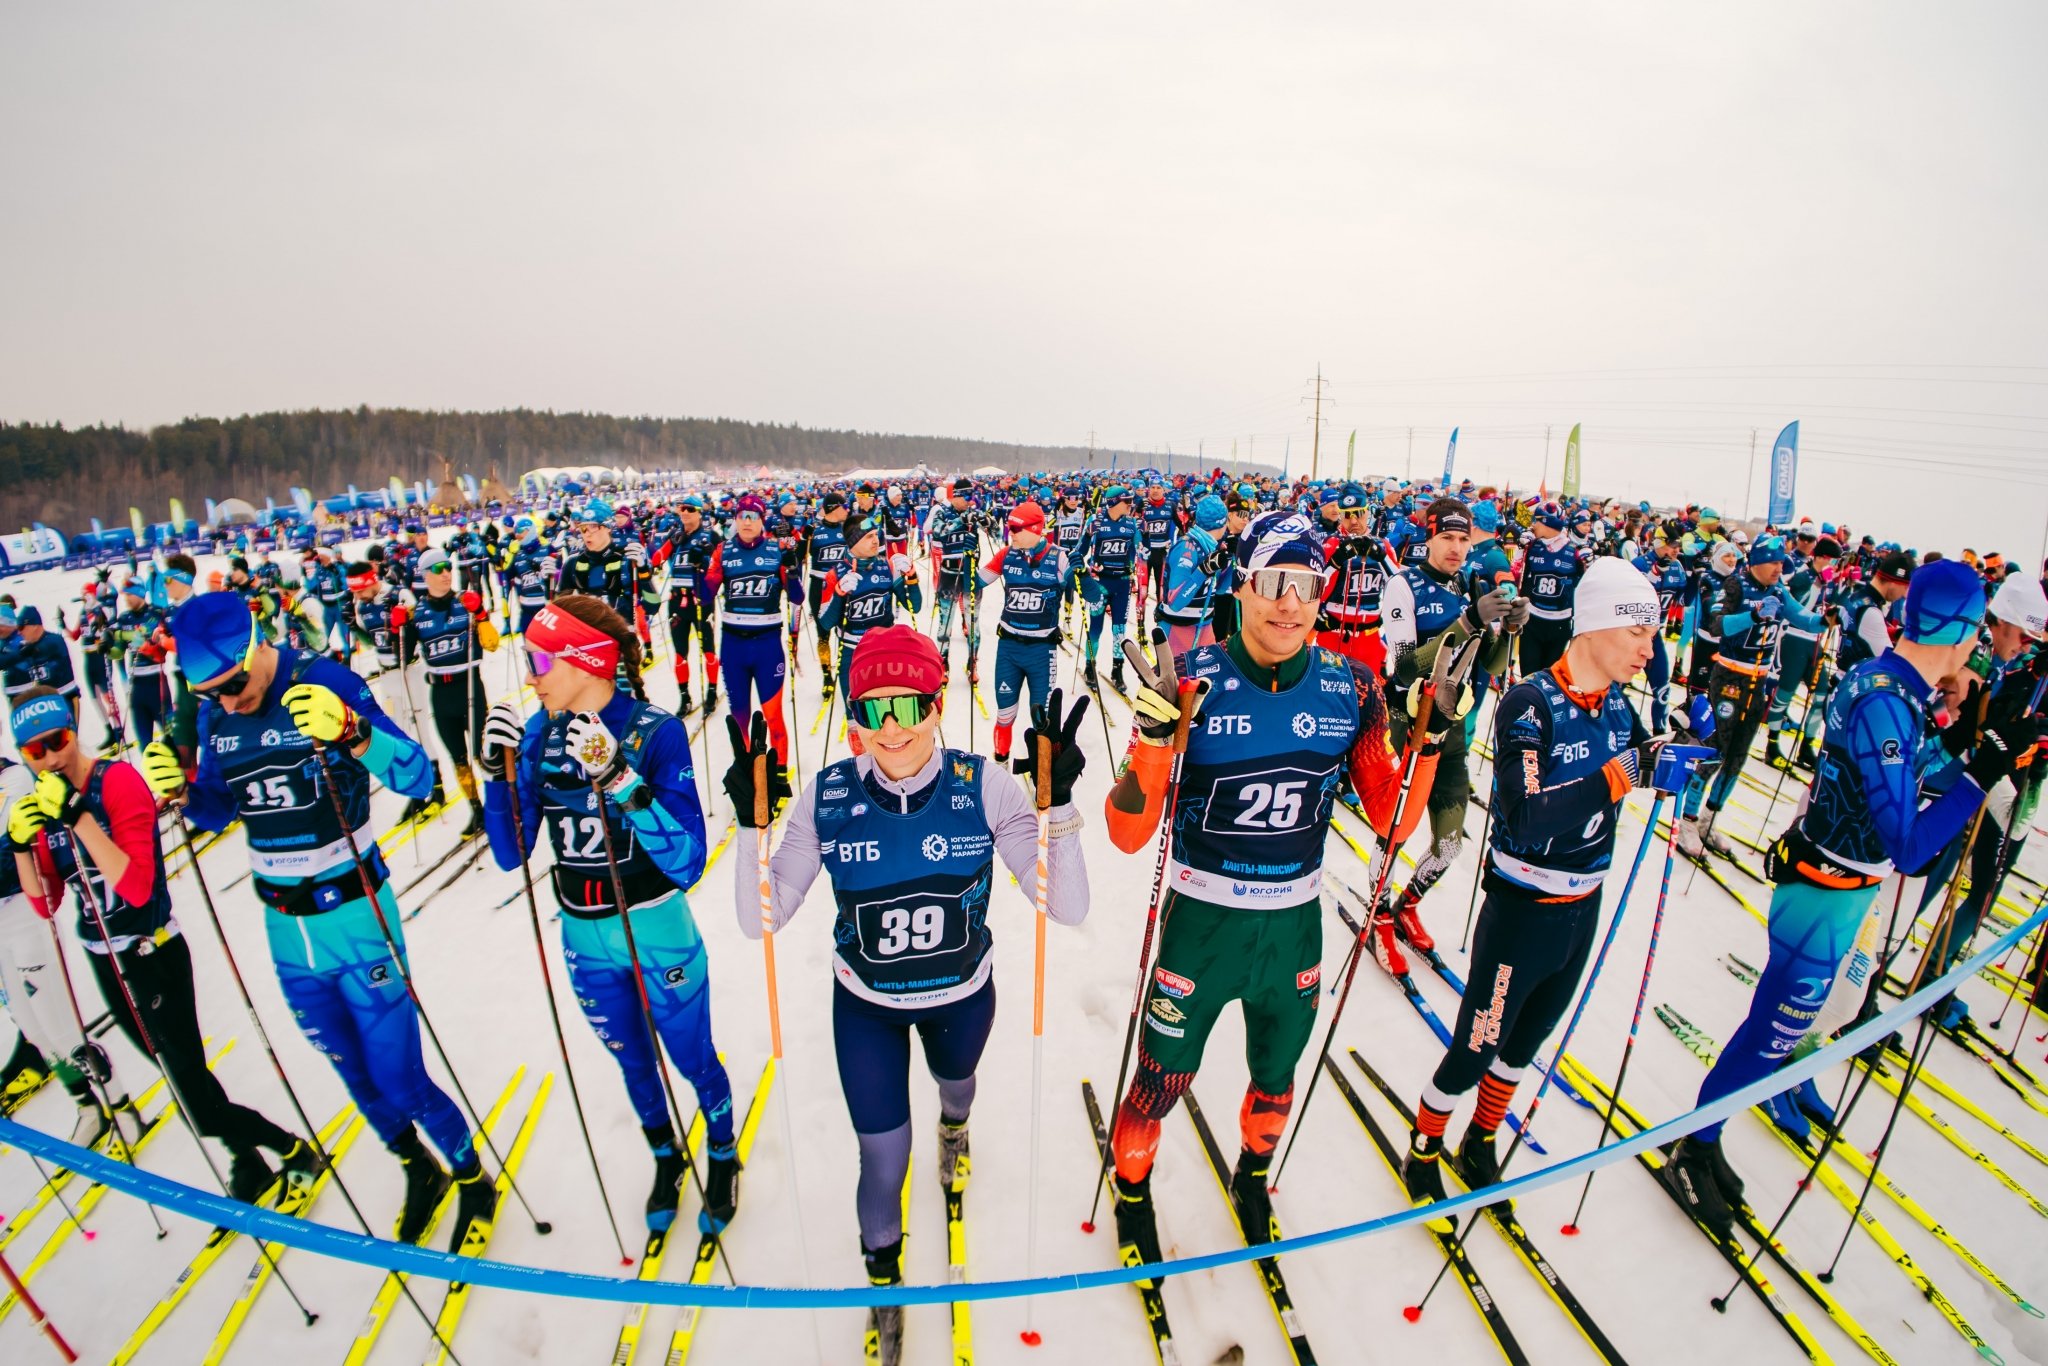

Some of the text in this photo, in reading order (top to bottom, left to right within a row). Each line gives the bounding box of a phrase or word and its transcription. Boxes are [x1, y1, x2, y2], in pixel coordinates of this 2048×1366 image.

[1778, 451, 1789, 495] ЮМС
[1060, 528, 1079, 539] 105
[1148, 522, 1167, 533] 134
[820, 547, 844, 560] 157
[1102, 541, 1126, 554] 241
[1008, 566, 1022, 576] ВТБ
[732, 583, 768, 597] 214
[1537, 577, 1556, 595] 68
[851, 601, 883, 619] 247
[1008, 590, 1043, 611] 295
[12, 700, 62, 729] LUKOIL
[1318, 716, 1352, 725] ЮГОРСКИЙ
[1207, 714, 1252, 735] ВТБ
[216, 735, 242, 754] ВТБ
[1563, 741, 1590, 764] ВТБ
[246, 775, 295, 808] 15
[826, 788, 846, 798] ЮМС
[1233, 780, 1308, 828] 25
[558, 816, 607, 859] 12
[951, 834, 990, 843] ЮГОРСКИЙ
[275, 856, 310, 865] ЮГОРИЯ
[838, 840, 881, 863] ВТБ
[951, 849, 985, 858] МАРАФОН
[1249, 885, 1292, 895] ЮГОРИЯ
[878, 905, 945, 955] 39
[902, 992, 949, 1004] ЮГОРИЯ
[1485, 963, 1513, 1046] ROMANOV
[1468, 1008, 1489, 1052] TEAM
[1679, 1167, 1699, 1205] SPINE
[1953, 1242, 2025, 1304] FISCHER
[1916, 1274, 1987, 1349] FISCHER
